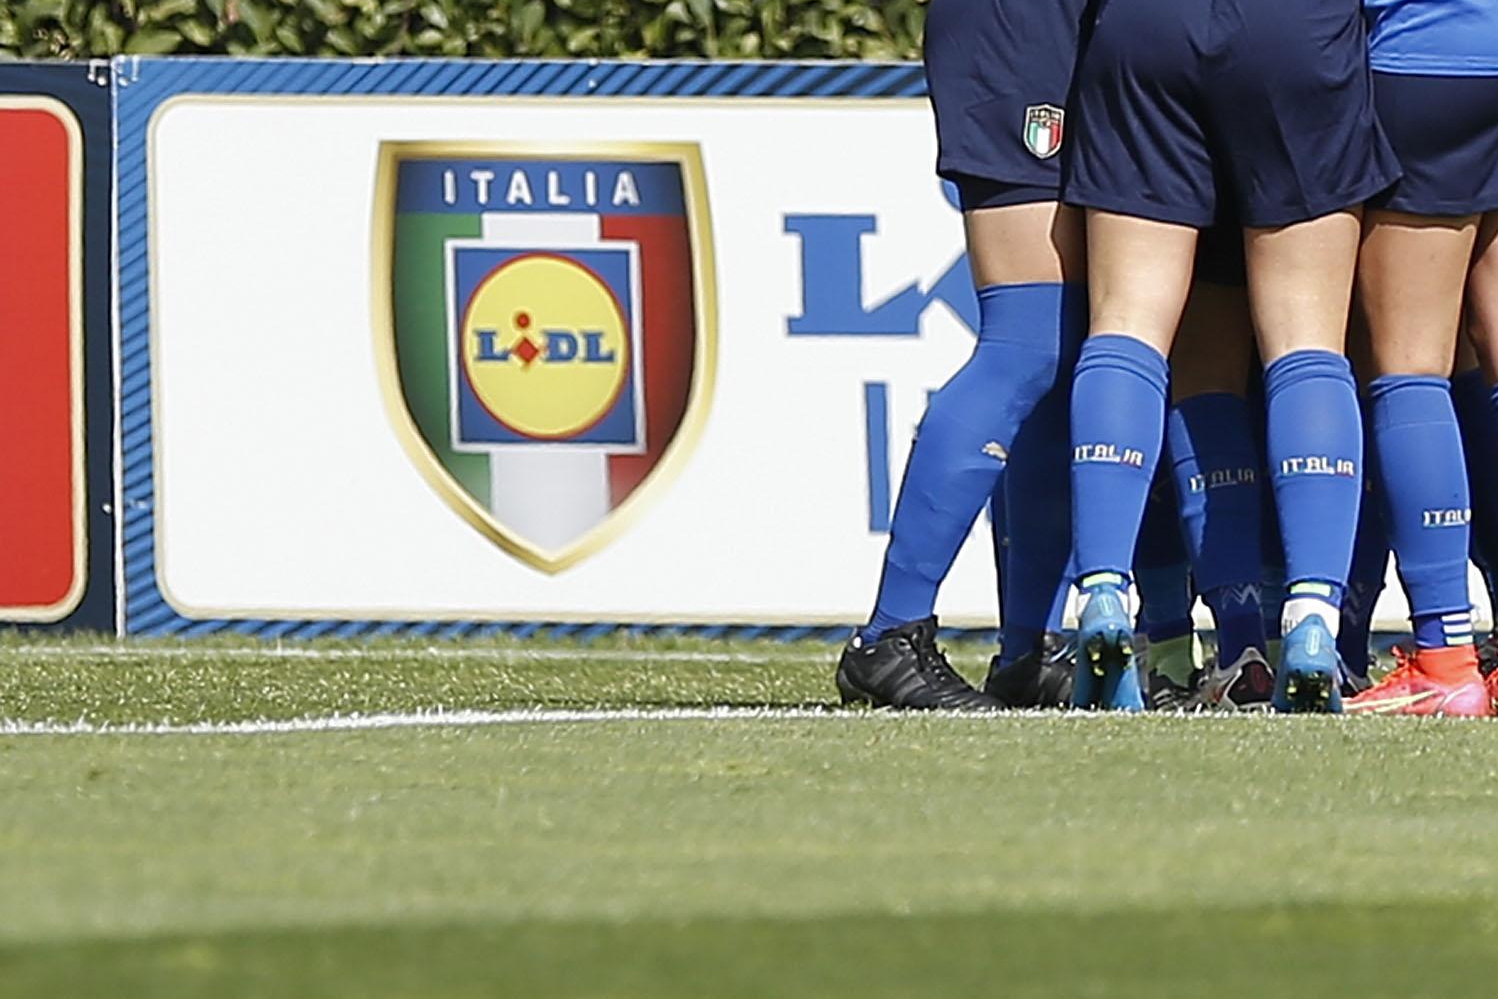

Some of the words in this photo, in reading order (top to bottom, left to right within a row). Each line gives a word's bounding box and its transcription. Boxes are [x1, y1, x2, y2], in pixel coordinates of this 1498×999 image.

[443, 169, 641, 207] ITALIA
[1073, 444, 1143, 468] ITALIA
[1281, 456, 1355, 479] ITALIA
[1423, 508, 1472, 526] ITALI
